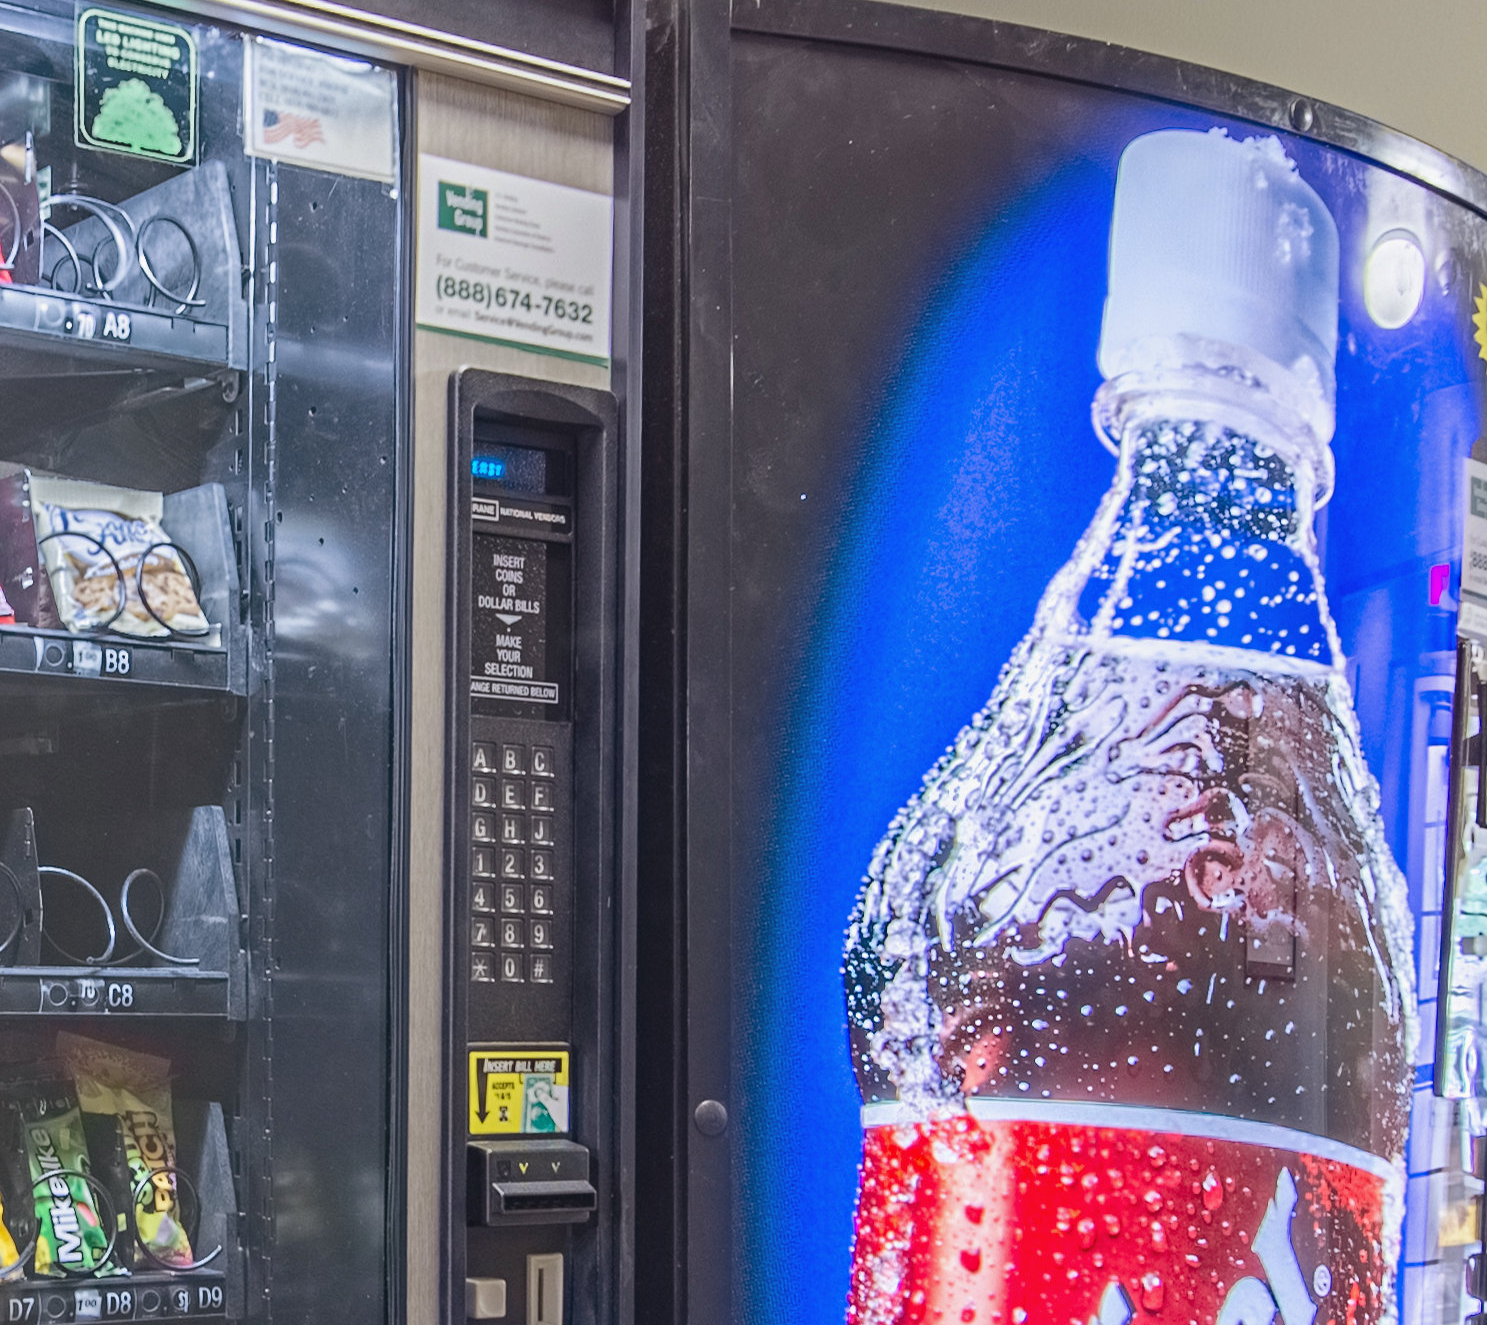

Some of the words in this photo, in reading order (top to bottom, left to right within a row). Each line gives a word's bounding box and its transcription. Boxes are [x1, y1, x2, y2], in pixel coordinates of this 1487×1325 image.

[436, 254, 452, 269] For
[455, 259, 502, 277] Customer
[103, 312, 131, 339] A8
[472, 503, 495, 516] RANE
[500, 507, 532, 521] NATIONAL
[493, 554, 524, 569] INSERT
[495, 569, 523, 584] COINS
[502, 584, 515, 597] OR
[478, 595, 513, 611] DOLLAR
[515, 599, 540, 614] BILLS
[496, 634, 522, 650] MAKE
[105, 649, 130, 674] B8
[496, 648, 521, 664] YOUR
[484, 662, 533, 679] SELECTION
[492, 683, 528, 696] RETURNED
[530, 688, 557, 699] BELOW
[474, 748, 486, 767] A
[505, 750, 516, 769] B
[534, 752, 545, 772] C
[475, 783, 486, 802] D
[505, 785, 515, 804] E
[534, 787, 544, 806] F
[475, 818, 486, 837] G
[504, 820, 515, 839] H
[534, 821, 544, 840] J
[476, 854, 484, 872] 1
[504, 854, 515, 874] 2
[534, 855, 544, 874] 3
[474, 888, 485, 907] 4
[504, 889, 515, 908] 5
[534, 889, 544, 908] 6
[475, 923, 486, 943] 7
[504, 924, 515, 943] 8
[534, 924, 544, 944] 9
[504, 958, 515, 977] 0
[108, 983, 134, 1008] C8
[483, 1058, 513, 1073] INSERT
[515, 1059, 533, 1073] BILL
[535, 1058, 557, 1073] HERE
[127, 1110, 174, 1214] PATCH
[48, 1176, 84, 1264] Mike
[106, 1291, 133, 1316] D8
[198, 1286, 223, 1309] D9
[8, 1297, 35, 1322] D7
